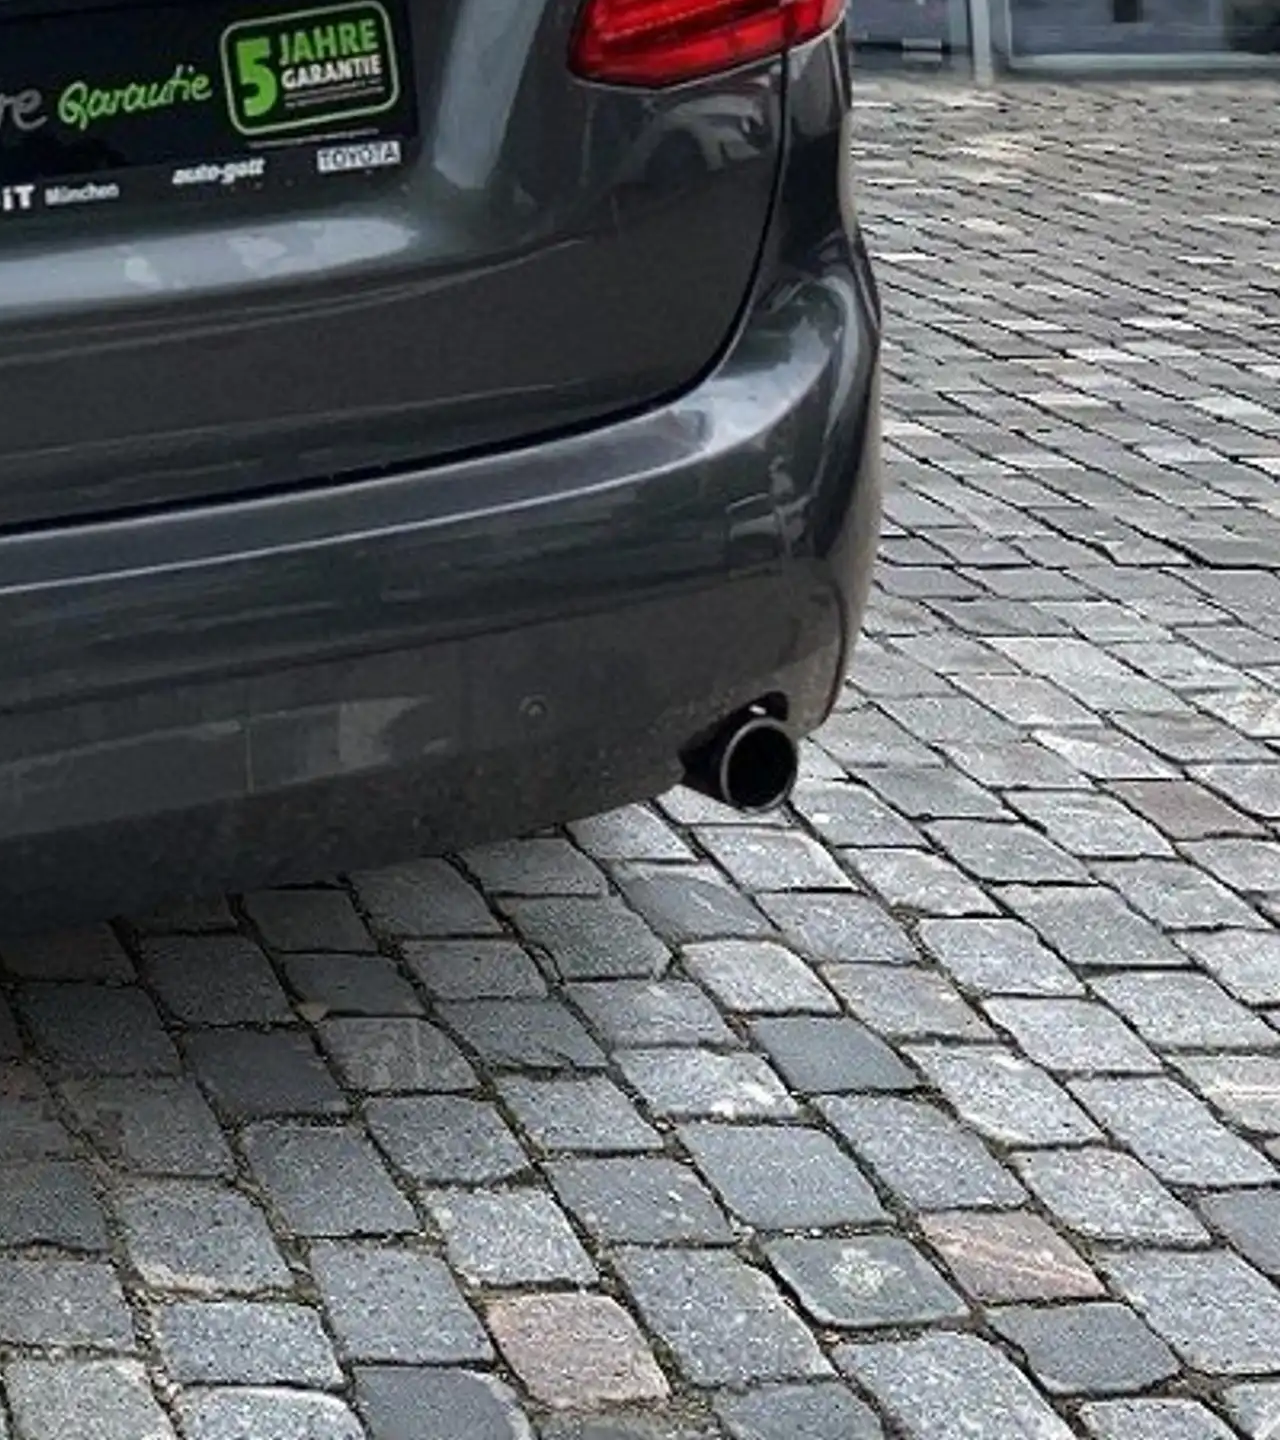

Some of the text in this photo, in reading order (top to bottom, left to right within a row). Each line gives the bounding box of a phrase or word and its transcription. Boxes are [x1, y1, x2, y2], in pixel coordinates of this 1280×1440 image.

[236, 36, 279, 117] 5
[278, 18, 380, 66] JAHRE
[281, 54, 383, 90] GARANTIE
[44, 182, 120, 207] München
[317, 140, 401, 173] TOYOTA
